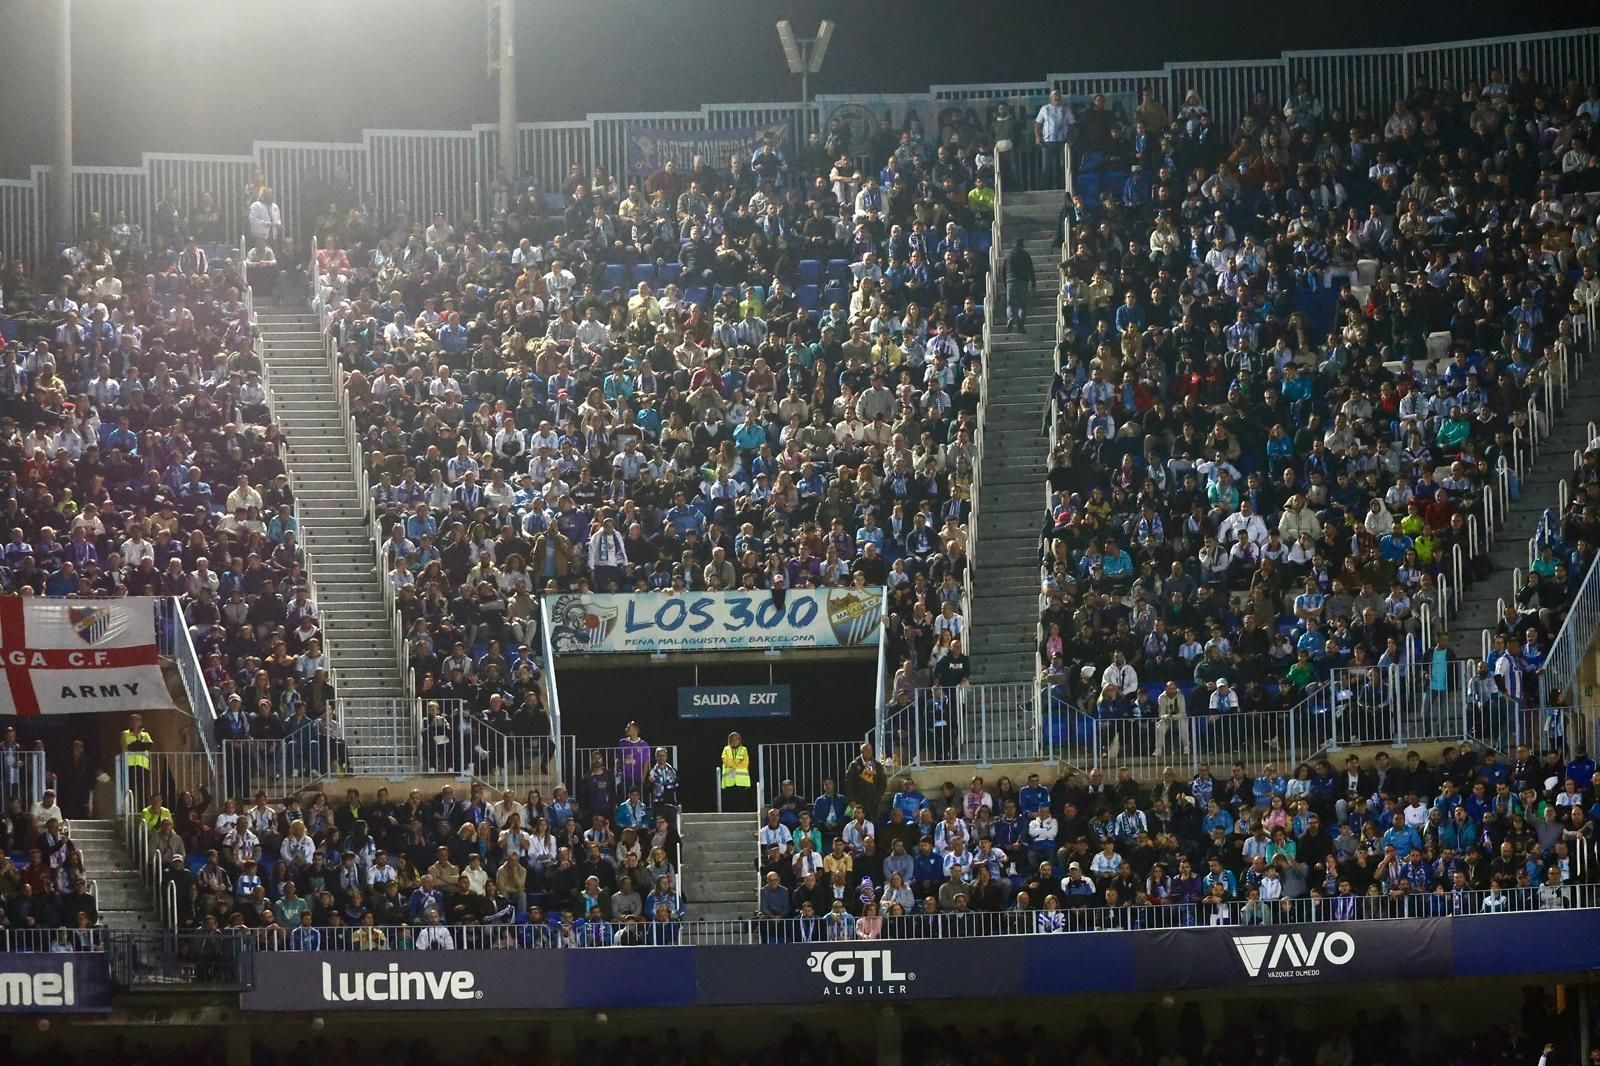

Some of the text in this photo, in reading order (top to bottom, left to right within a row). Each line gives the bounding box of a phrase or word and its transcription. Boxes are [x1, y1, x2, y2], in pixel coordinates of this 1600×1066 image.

[624, 595, 819, 634] LOS 300
[658, 636, 727, 646] MALAGUISTA
[730, 635, 745, 644] DE
[748, 634, 816, 643] BARCELONA
[0, 651, 111, 667] GA C.F.
[61, 682, 140, 699] ARMY
[693, 692, 778, 706] SALIDA EXIT
[823, 949, 906, 984] GTL
[1295, 969, 1320, 977] OLMEDO
[322, 961, 475, 1002] lucinve
[823, 985, 907, 996] ALQUILER
